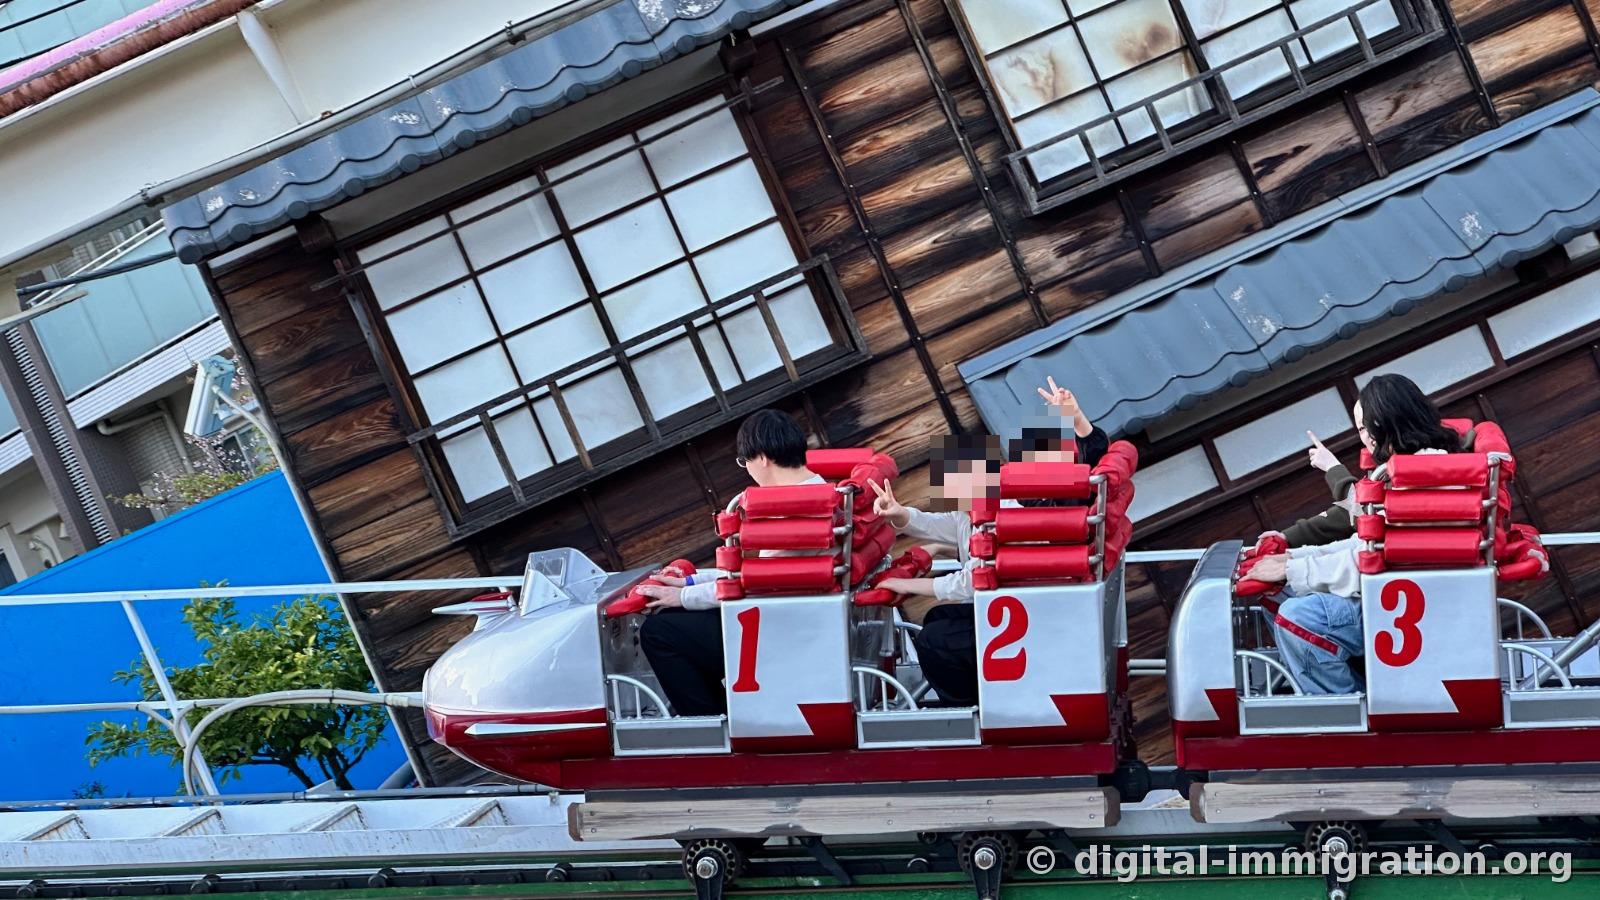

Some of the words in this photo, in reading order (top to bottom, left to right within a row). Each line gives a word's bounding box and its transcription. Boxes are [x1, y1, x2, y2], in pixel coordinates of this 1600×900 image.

[732, 606, 760, 692] 1
[983, 595, 1029, 682] 2
[1374, 578, 1426, 667] 3
